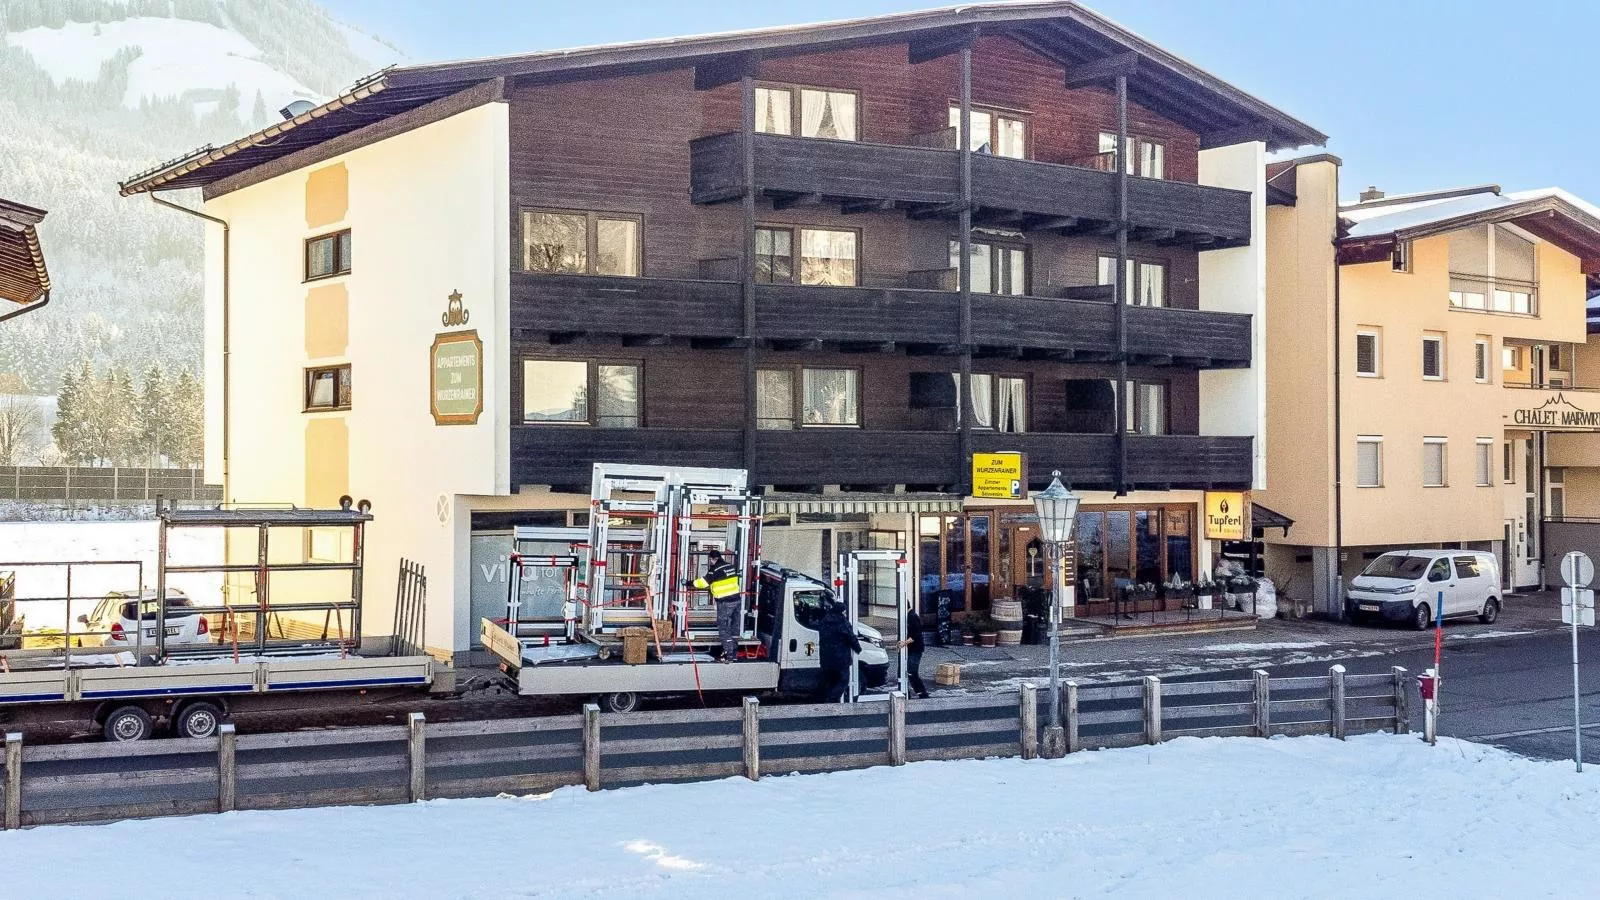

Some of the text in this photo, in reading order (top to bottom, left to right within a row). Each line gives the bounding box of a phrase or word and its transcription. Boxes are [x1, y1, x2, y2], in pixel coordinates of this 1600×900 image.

[436, 354, 476, 368] APPARTEMENTS
[450, 371, 462, 384] ZUM
[1514, 409, 1557, 425] CHALET
[1208, 514, 1241, 533] Tupferl
